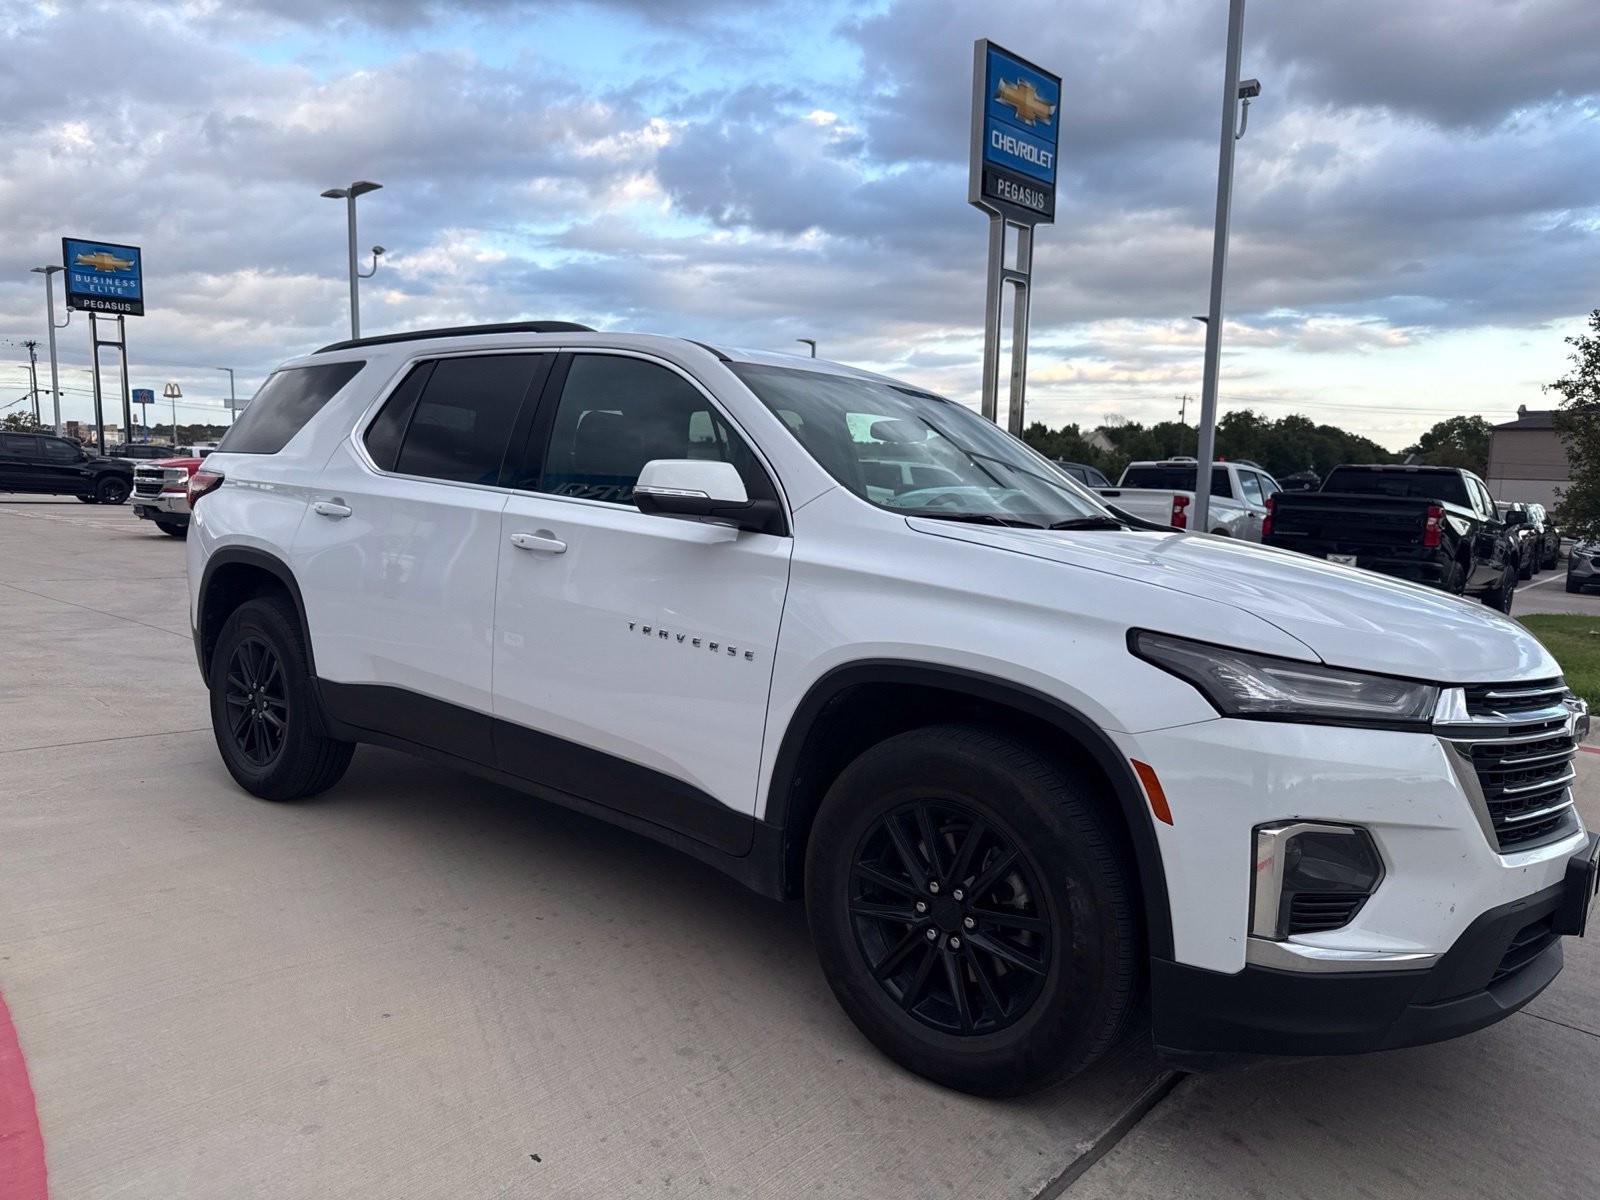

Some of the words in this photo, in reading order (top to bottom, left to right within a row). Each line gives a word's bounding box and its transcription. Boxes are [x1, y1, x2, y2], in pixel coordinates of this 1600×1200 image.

[991, 130, 1053, 169] CHEVROLET
[997, 179, 1045, 209] PEGASUS
[75, 275, 136, 288] BUSINESS
[90, 284, 124, 295] ELITE
[83, 300, 131, 312] PEGASUS
[628, 621, 754, 662] TRAVERSE
